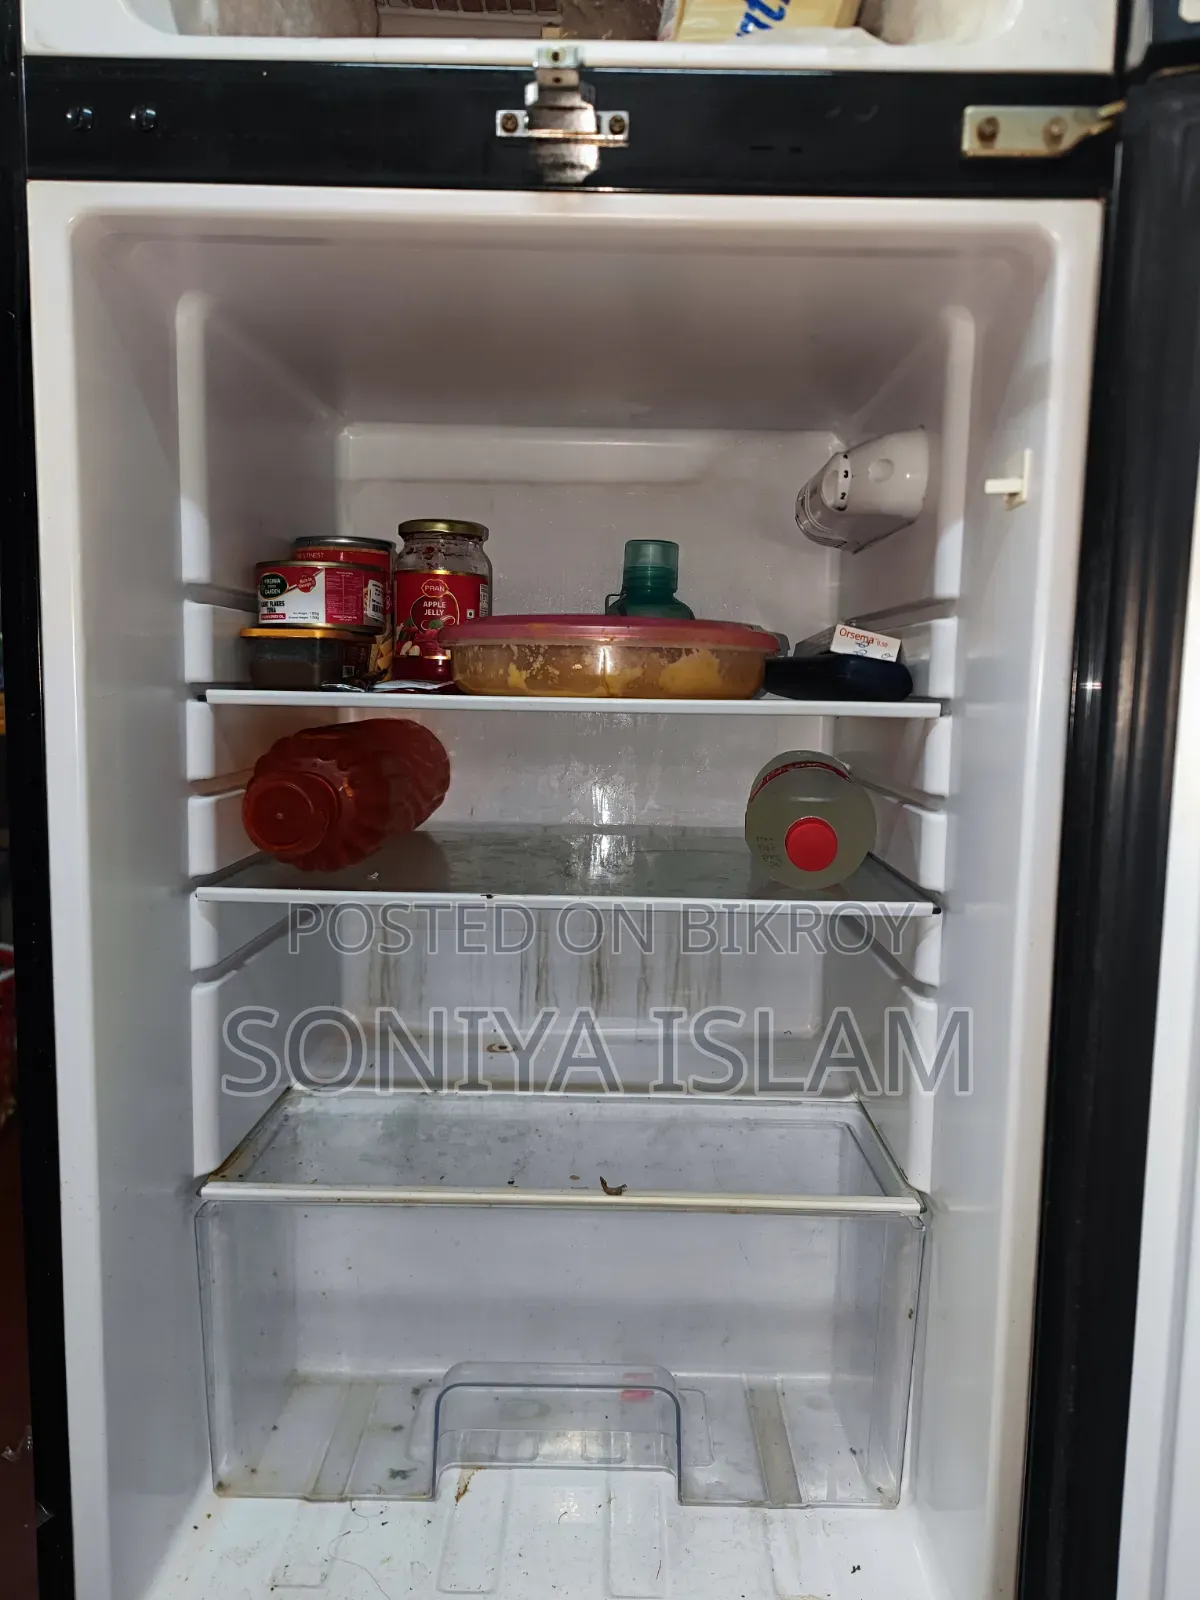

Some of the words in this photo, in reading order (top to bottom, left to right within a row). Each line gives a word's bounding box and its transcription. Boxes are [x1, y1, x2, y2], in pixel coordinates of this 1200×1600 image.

[843, 470, 849, 478] 3
[840, 492, 846, 500] 2
[839, 627, 875, 645] Orsema
